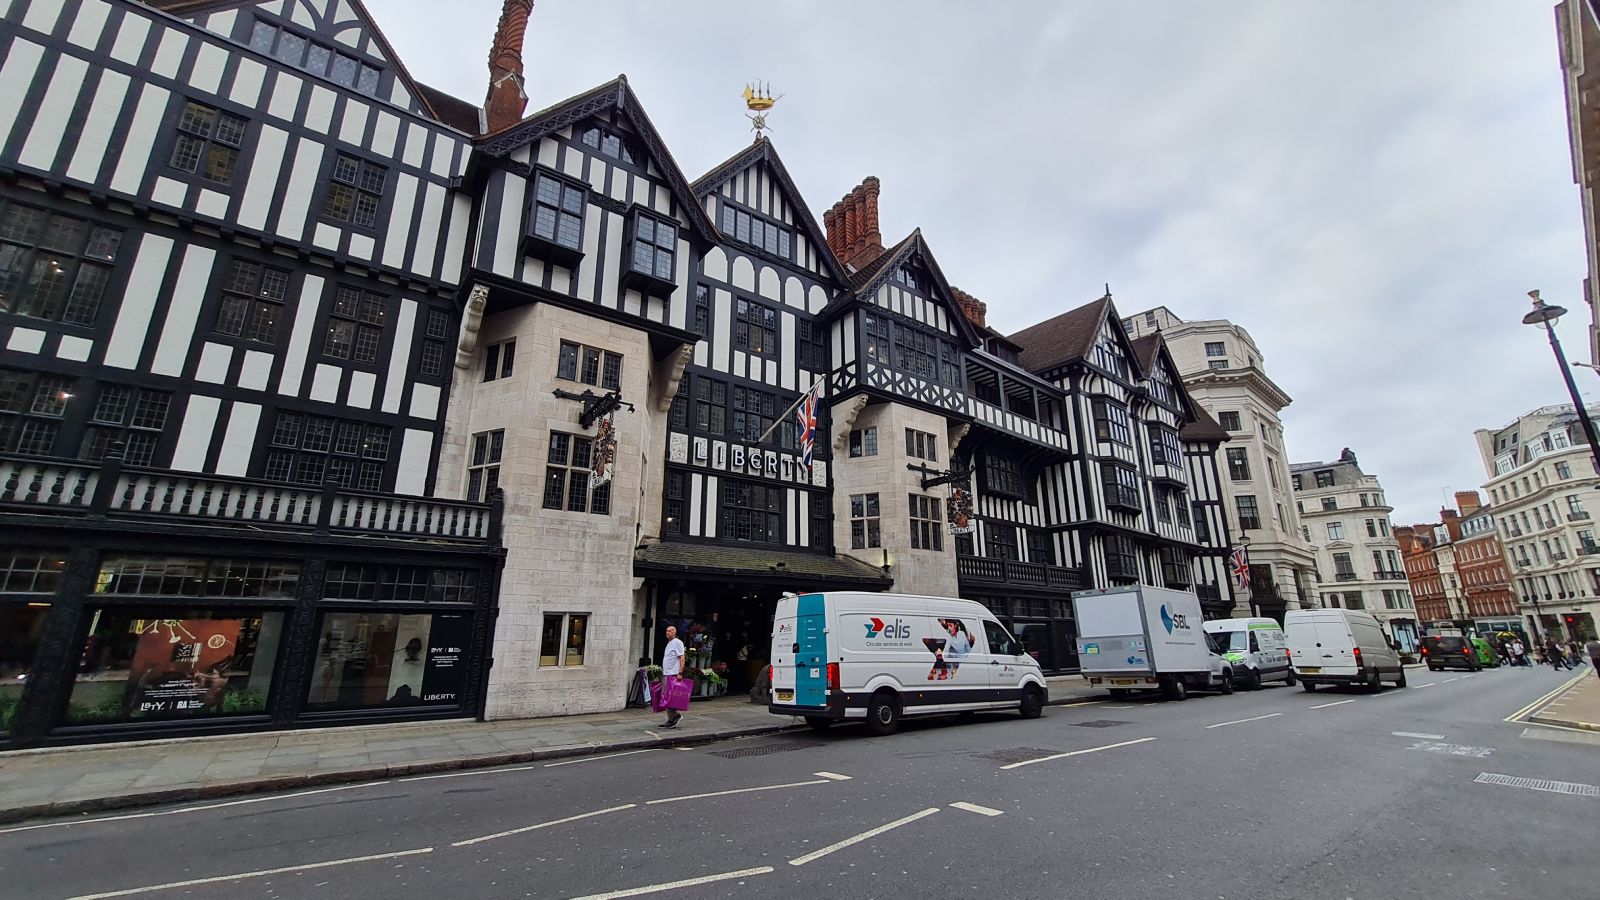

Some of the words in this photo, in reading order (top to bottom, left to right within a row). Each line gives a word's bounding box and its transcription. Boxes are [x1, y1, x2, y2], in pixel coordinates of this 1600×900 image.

[695, 441, 808, 480] LIBERTY
[884, 618, 910, 638] elis
[1173, 613, 1190, 629] SBL
